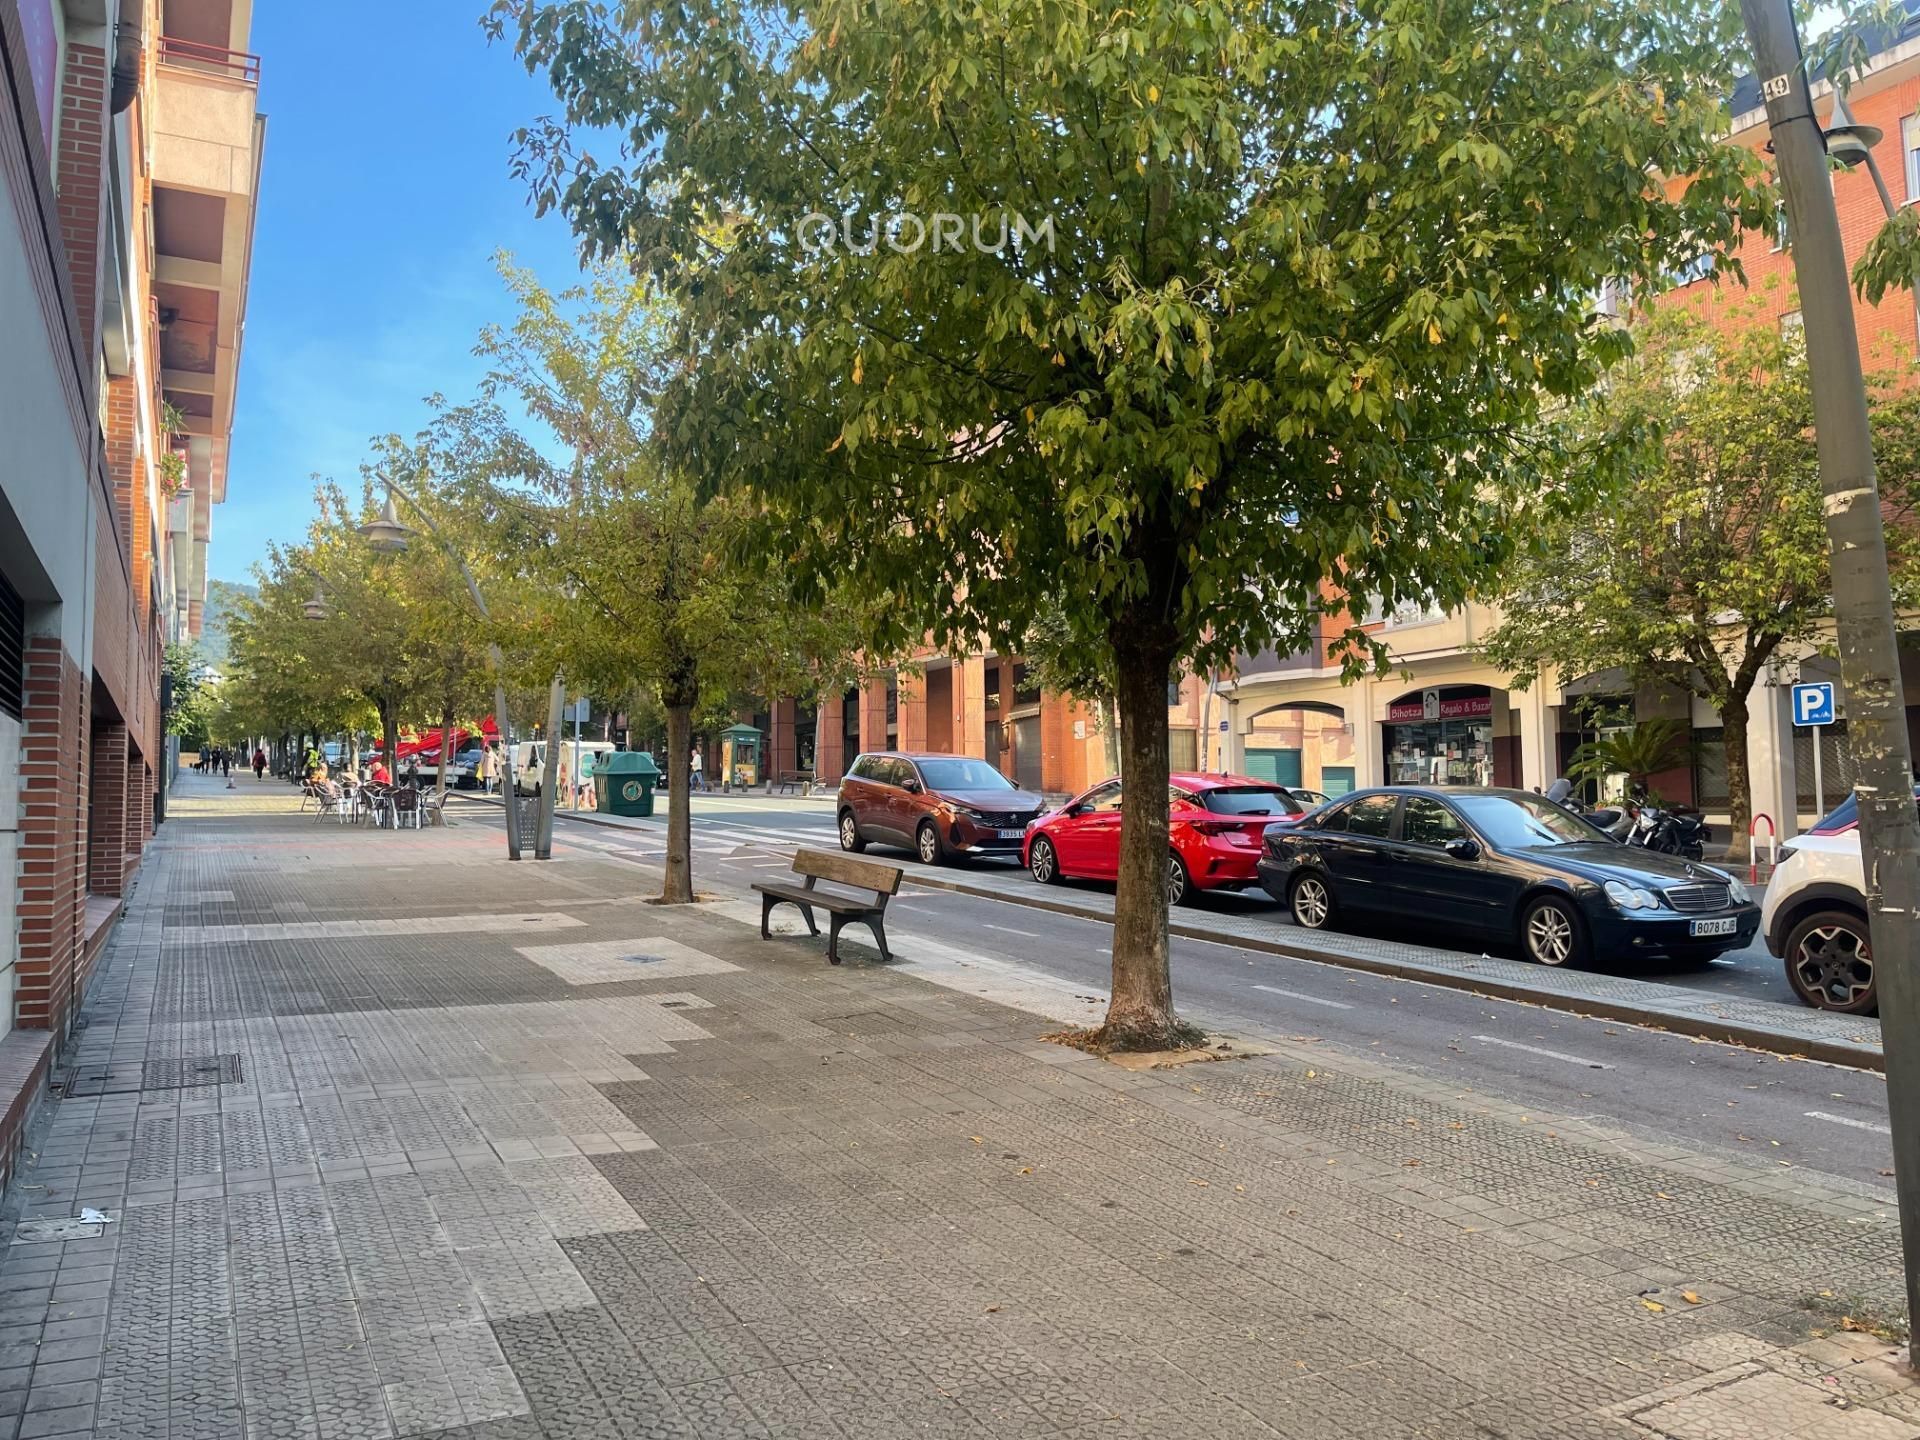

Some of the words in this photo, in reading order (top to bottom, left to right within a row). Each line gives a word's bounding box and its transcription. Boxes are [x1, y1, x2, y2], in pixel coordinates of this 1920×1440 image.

[1766, 78, 1787, 97] 49
[1440, 703, 1462, 716] Regalo
[1464, 702, 1470, 712] &
[1800, 688, 1825, 721] P
[1391, 708, 1423, 719] Bihotza
[1697, 922, 1720, 934] 8078
[1721, 920, 1735, 932] CJB
